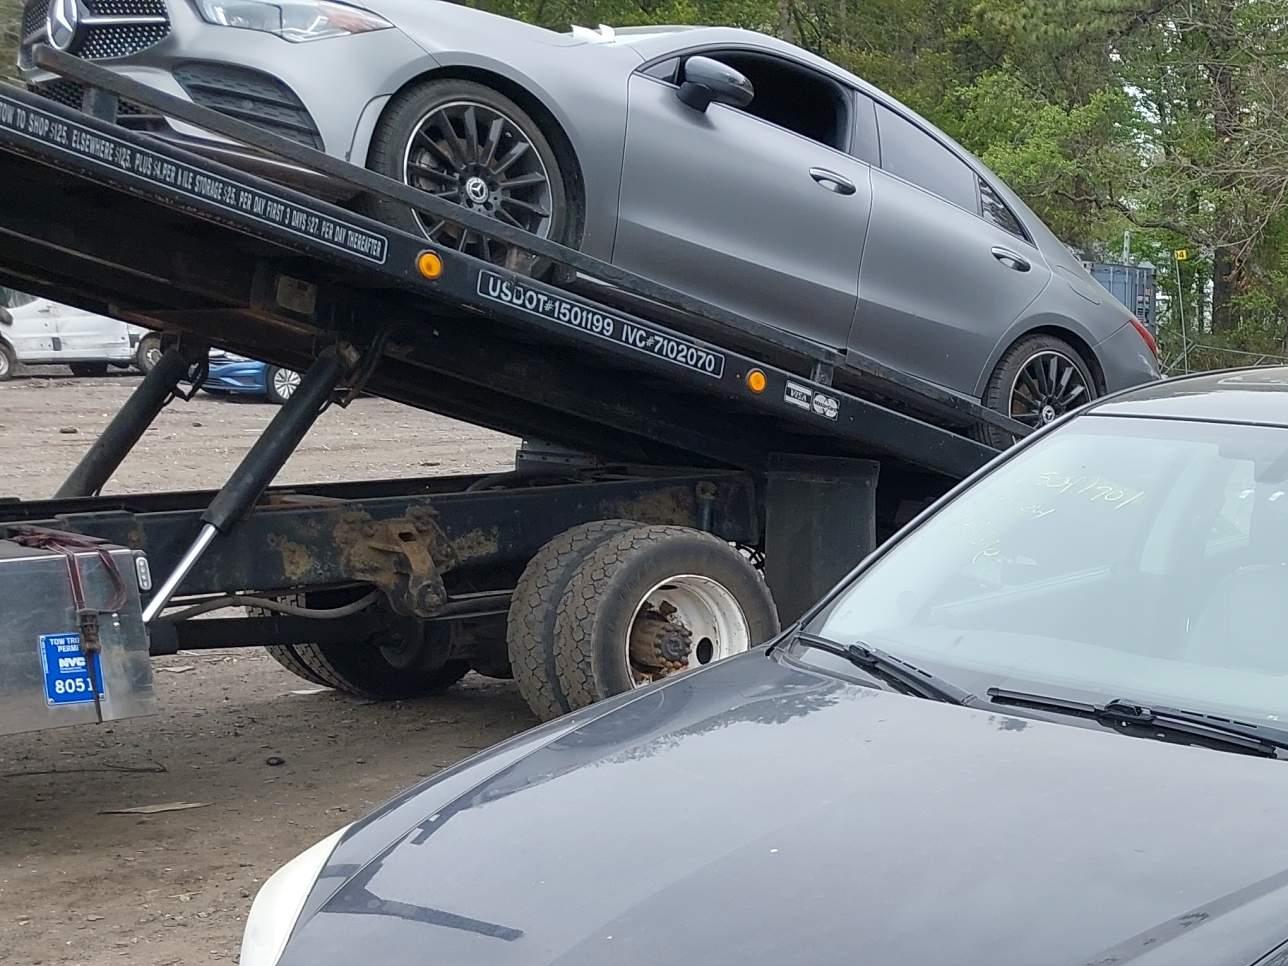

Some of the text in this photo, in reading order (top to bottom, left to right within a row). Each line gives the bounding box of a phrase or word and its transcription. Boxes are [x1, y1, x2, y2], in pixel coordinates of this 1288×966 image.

[0, 102, 15, 124] OW
[16, 108, 26, 129] TO
[28, 113, 49, 137] SHOP
[71, 129, 114, 161] ELSEWHERE
[134, 153, 152, 176] PLUS
[162, 163, 176, 185] PER
[194, 174, 223, 200] STORAGE
[239, 190, 252, 211] PER
[253, 196, 266, 215] DAY
[266, 200, 285, 221] FIRST
[285, 207, 291, 225] 3
[291, 210, 307, 232] DAYS
[321, 220, 334, 240] PER
[334, 225, 347, 244] DAY
[347, 230, 382, 257] THEREAFTER
[488, 276, 716, 372] USDOT#1501199 IVC#7102070
[790, 388, 807, 401] VISA
[59, 657, 86, 667] NYC
[55, 678, 93, 693] 8051
